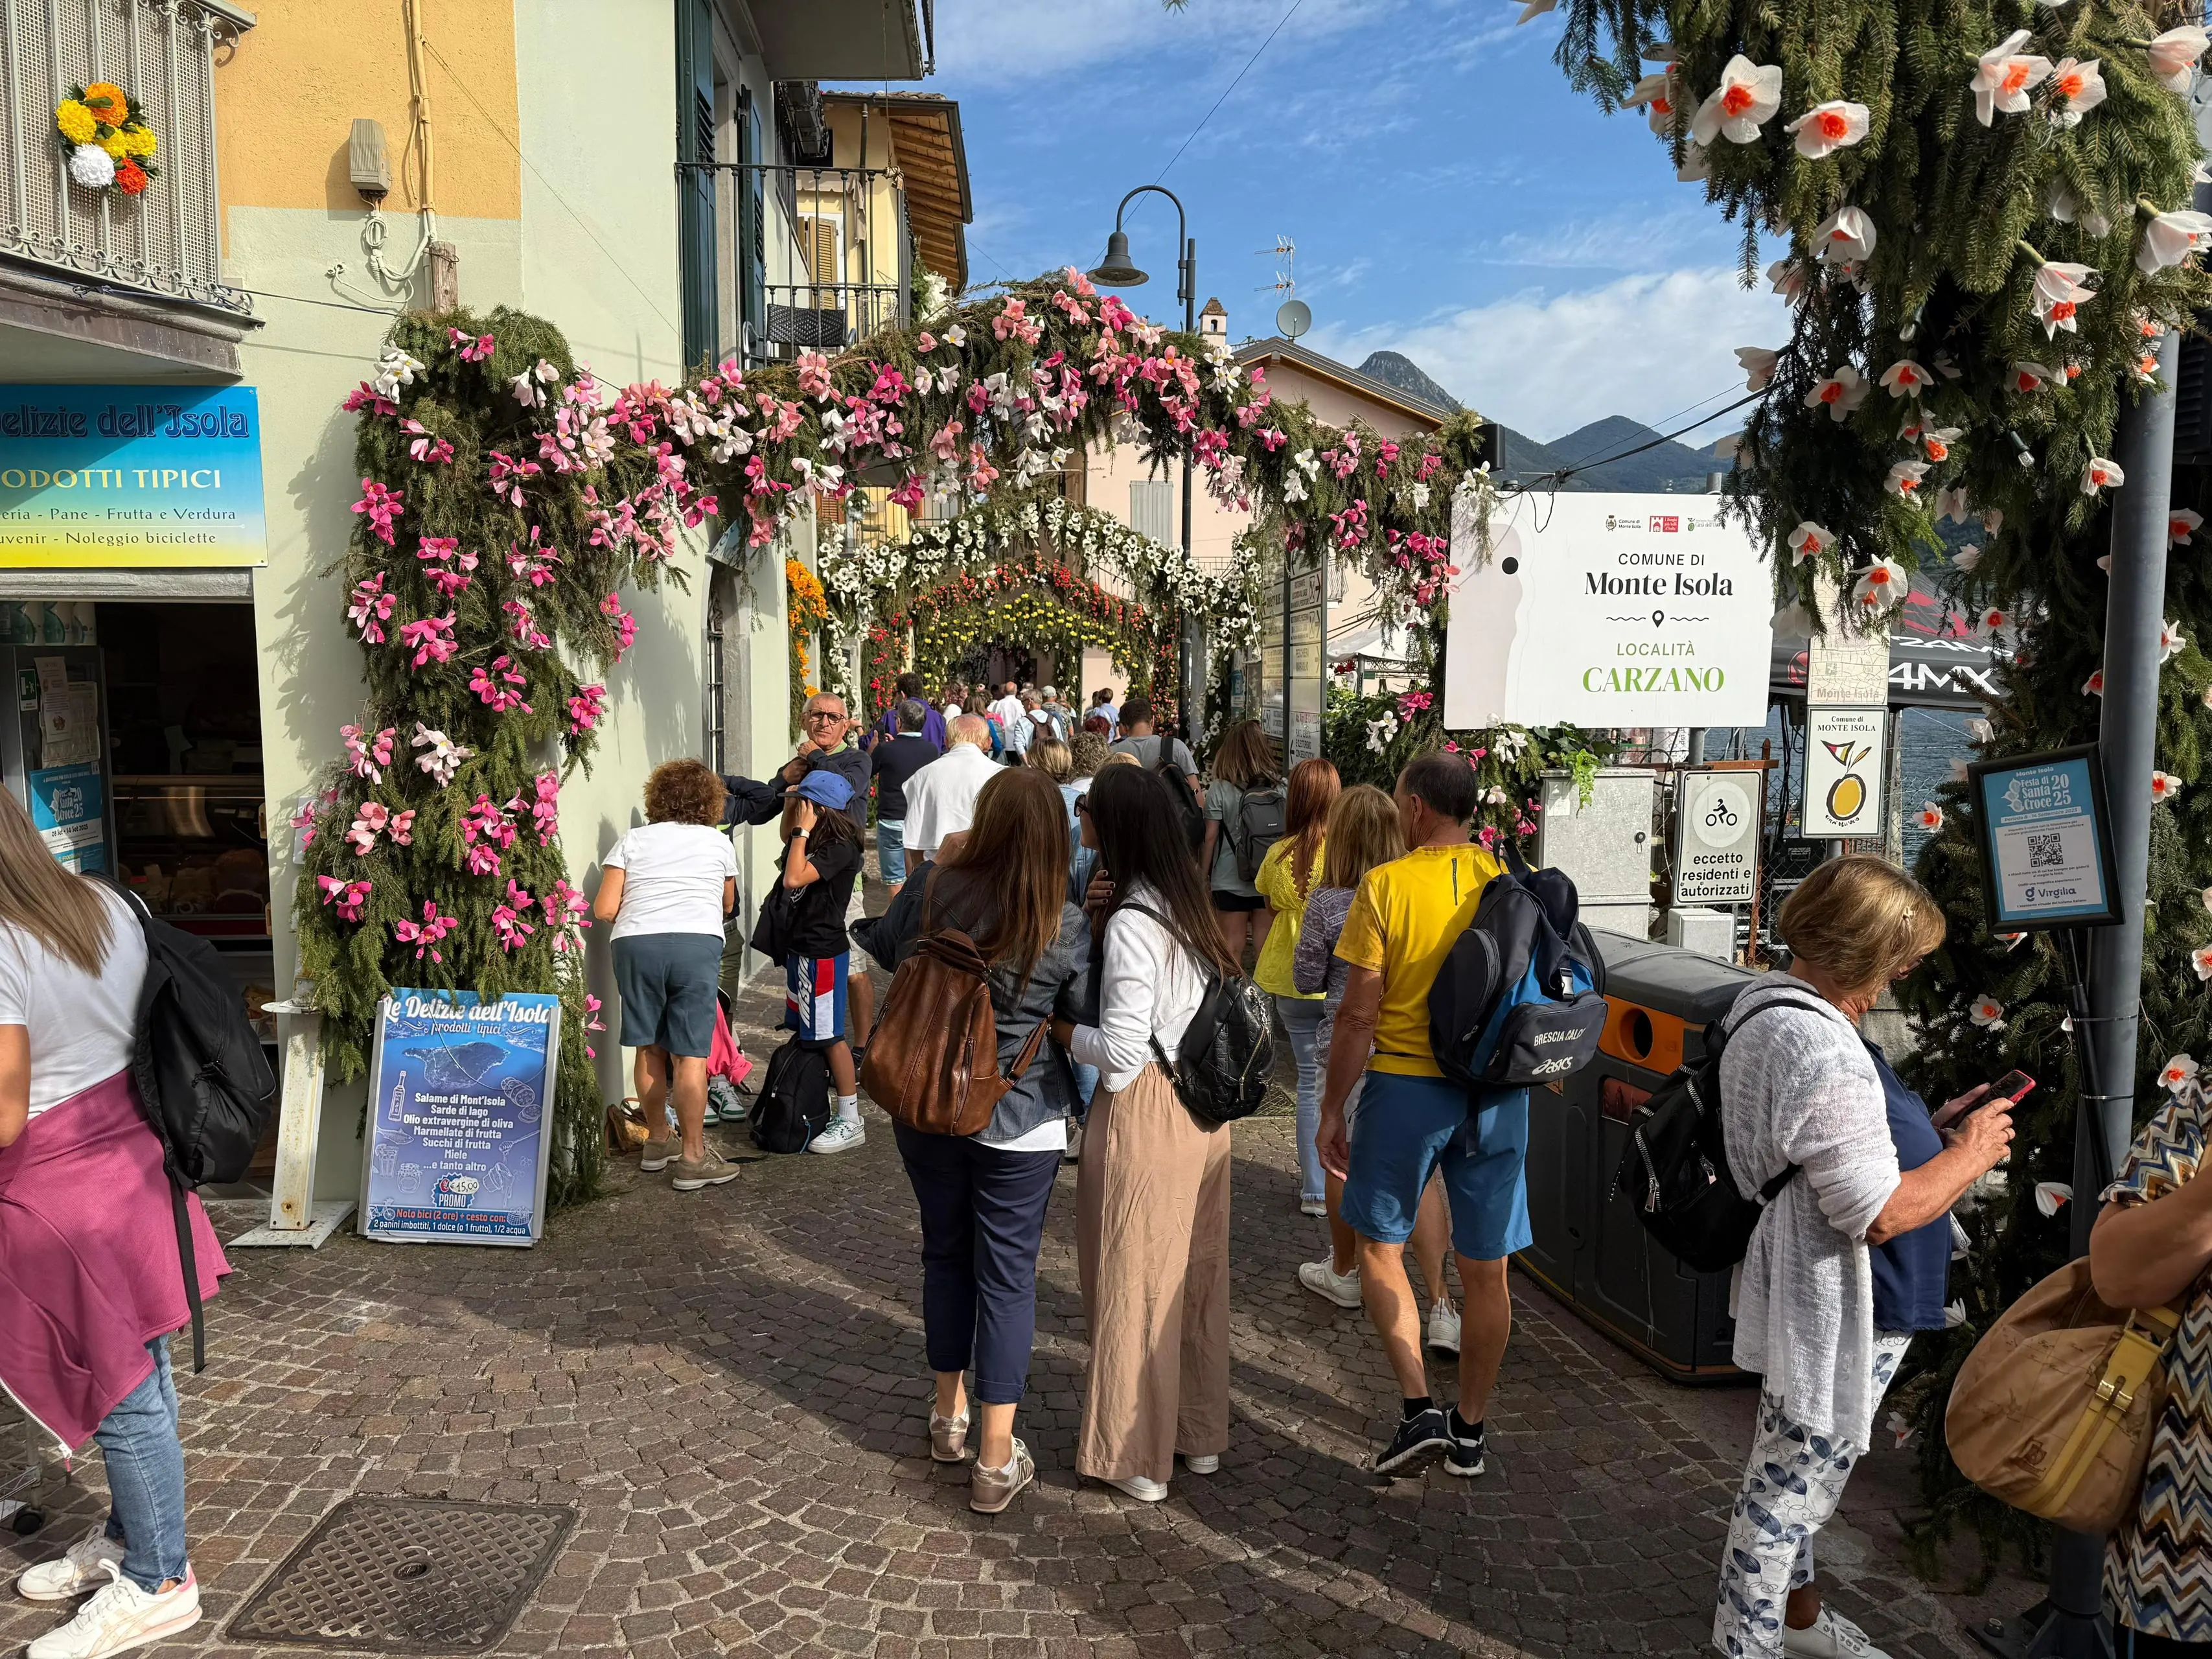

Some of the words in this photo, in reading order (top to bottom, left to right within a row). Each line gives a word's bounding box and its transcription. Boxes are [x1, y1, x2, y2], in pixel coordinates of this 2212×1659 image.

[0, 404, 87, 437] elizie
[96, 404, 249, 438] dell'Isola
[1, 469, 123, 489] ODOTTI
[132, 469, 221, 489] TIPICI
[1, 509, 31, 520] eria
[50, 508, 89, 520] Pane
[107, 508, 153, 520] Frutta
[160, 511, 167, 520] e
[173, 508, 236, 520] Verdura
[0, 533, 47, 544] uvenir
[65, 532, 139, 547] Noleggio
[146, 533, 216, 544] biciclette
[1619, 553, 1685, 566] COMUNE
[1690, 554, 1705, 566] DI
[1585, 572, 1666, 596] Monte
[1674, 573, 1733, 596] Isola
[1617, 640, 1695, 656] LOCALITÀ
[1582, 667, 1725, 693] CARZANO
[1889, 662, 2001, 695] 4MX
[1817, 688, 1851, 698] Monte
[2021, 778, 2041, 787] Festa
[2042, 776, 2049, 785] di
[2051, 773, 2069, 791] 20
[2022, 785, 2051, 798] Santa
[2023, 796, 2052, 811] Croce
[2053, 790, 2072, 807] 25
[1693, 853, 1743, 864] eccetto
[1682, 867, 1740, 881] residenti
[1744, 869, 1751, 879] e
[1681, 883, 1749, 897] autorizzati
[2038, 887, 2077, 898] Virgilia
[430, 1021, 472, 1036] prodotti
[477, 1023, 503, 1038] tipici
[1534, 1030, 1565, 1047] BRESCIA
[1532, 1056, 1573, 1075] asics
[415, 1093, 448, 1104] Salame
[450, 1093, 459, 1104] di
[460, 1094, 506, 1107] Mont'Isola
[430, 1105, 457, 1115] Sarde
[459, 1106, 467, 1115] di
[468, 1106, 489, 1119] lago
[403, 1113, 421, 1125] Olio
[422, 1117, 479, 1129] extravergine
[481, 1117, 490, 1128] di
[491, 1118, 514, 1129] oliva
[413, 1125, 466, 1137] Marmellate
[467, 1128, 474, 1137] di
[476, 1128, 502, 1139] frutta
[422, 1137, 453, 1148] Succhi
[454, 1138, 463, 1148] di
[465, 1139, 491, 1150] frutta
[444, 1149, 468, 1159] Miele
[439, 1161, 463, 1170] tanto
[465, 1162, 487, 1172] altro
[437, 1194, 467, 1208] PROMO
[396, 1208, 416, 1218] Nolo
[417, 1209, 432, 1220] bici
[433, 1209, 441, 1220] (2
[443, 1209, 459, 1220] ore)
[466, 1212, 488, 1222] cesto
[489, 1213, 506, 1222] con:
[374, 1220, 378, 1228] 2
[379, 1220, 400, 1229] panini
[401, 1220, 431, 1231] imbottiti,
[437, 1222, 455, 1231] dolce
[457, 1223, 464, 1231] (o
[470, 1224, 492, 1234] frutto),
[494, 1225, 505, 1233] 1/2
[505, 1227, 525, 1235] acqua
